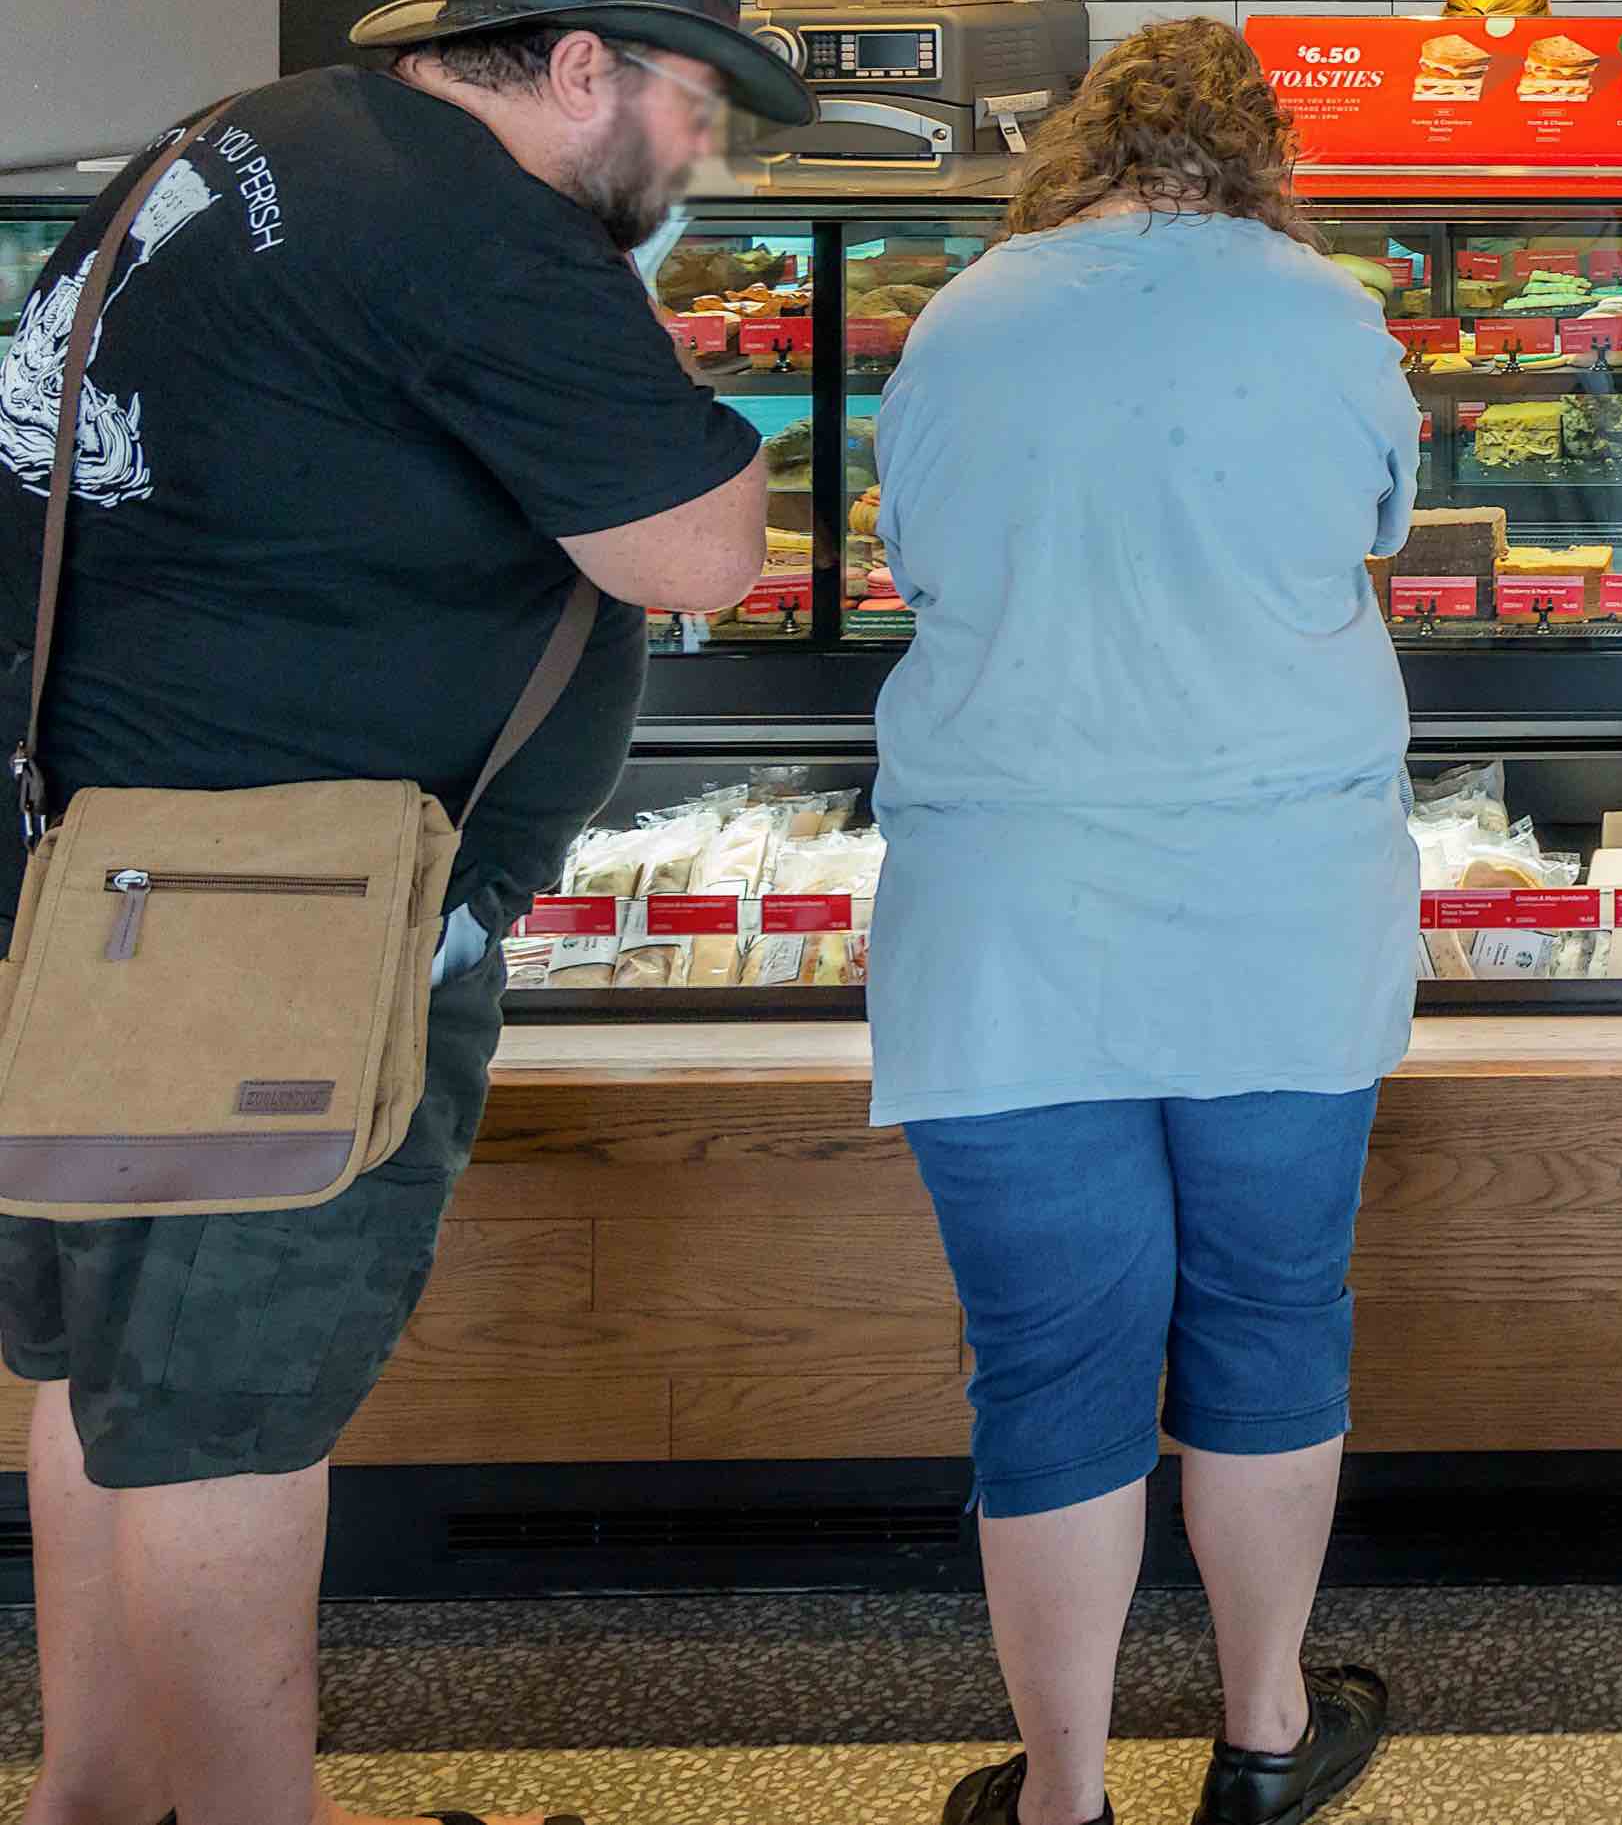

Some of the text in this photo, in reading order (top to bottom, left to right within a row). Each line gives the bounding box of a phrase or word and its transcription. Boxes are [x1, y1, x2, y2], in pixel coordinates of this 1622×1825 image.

[1297, 45, 1361, 63] $6.50
[1269, 70, 1384, 88] TOASTIES
[212, 126, 285, 253] YOU PERISH
